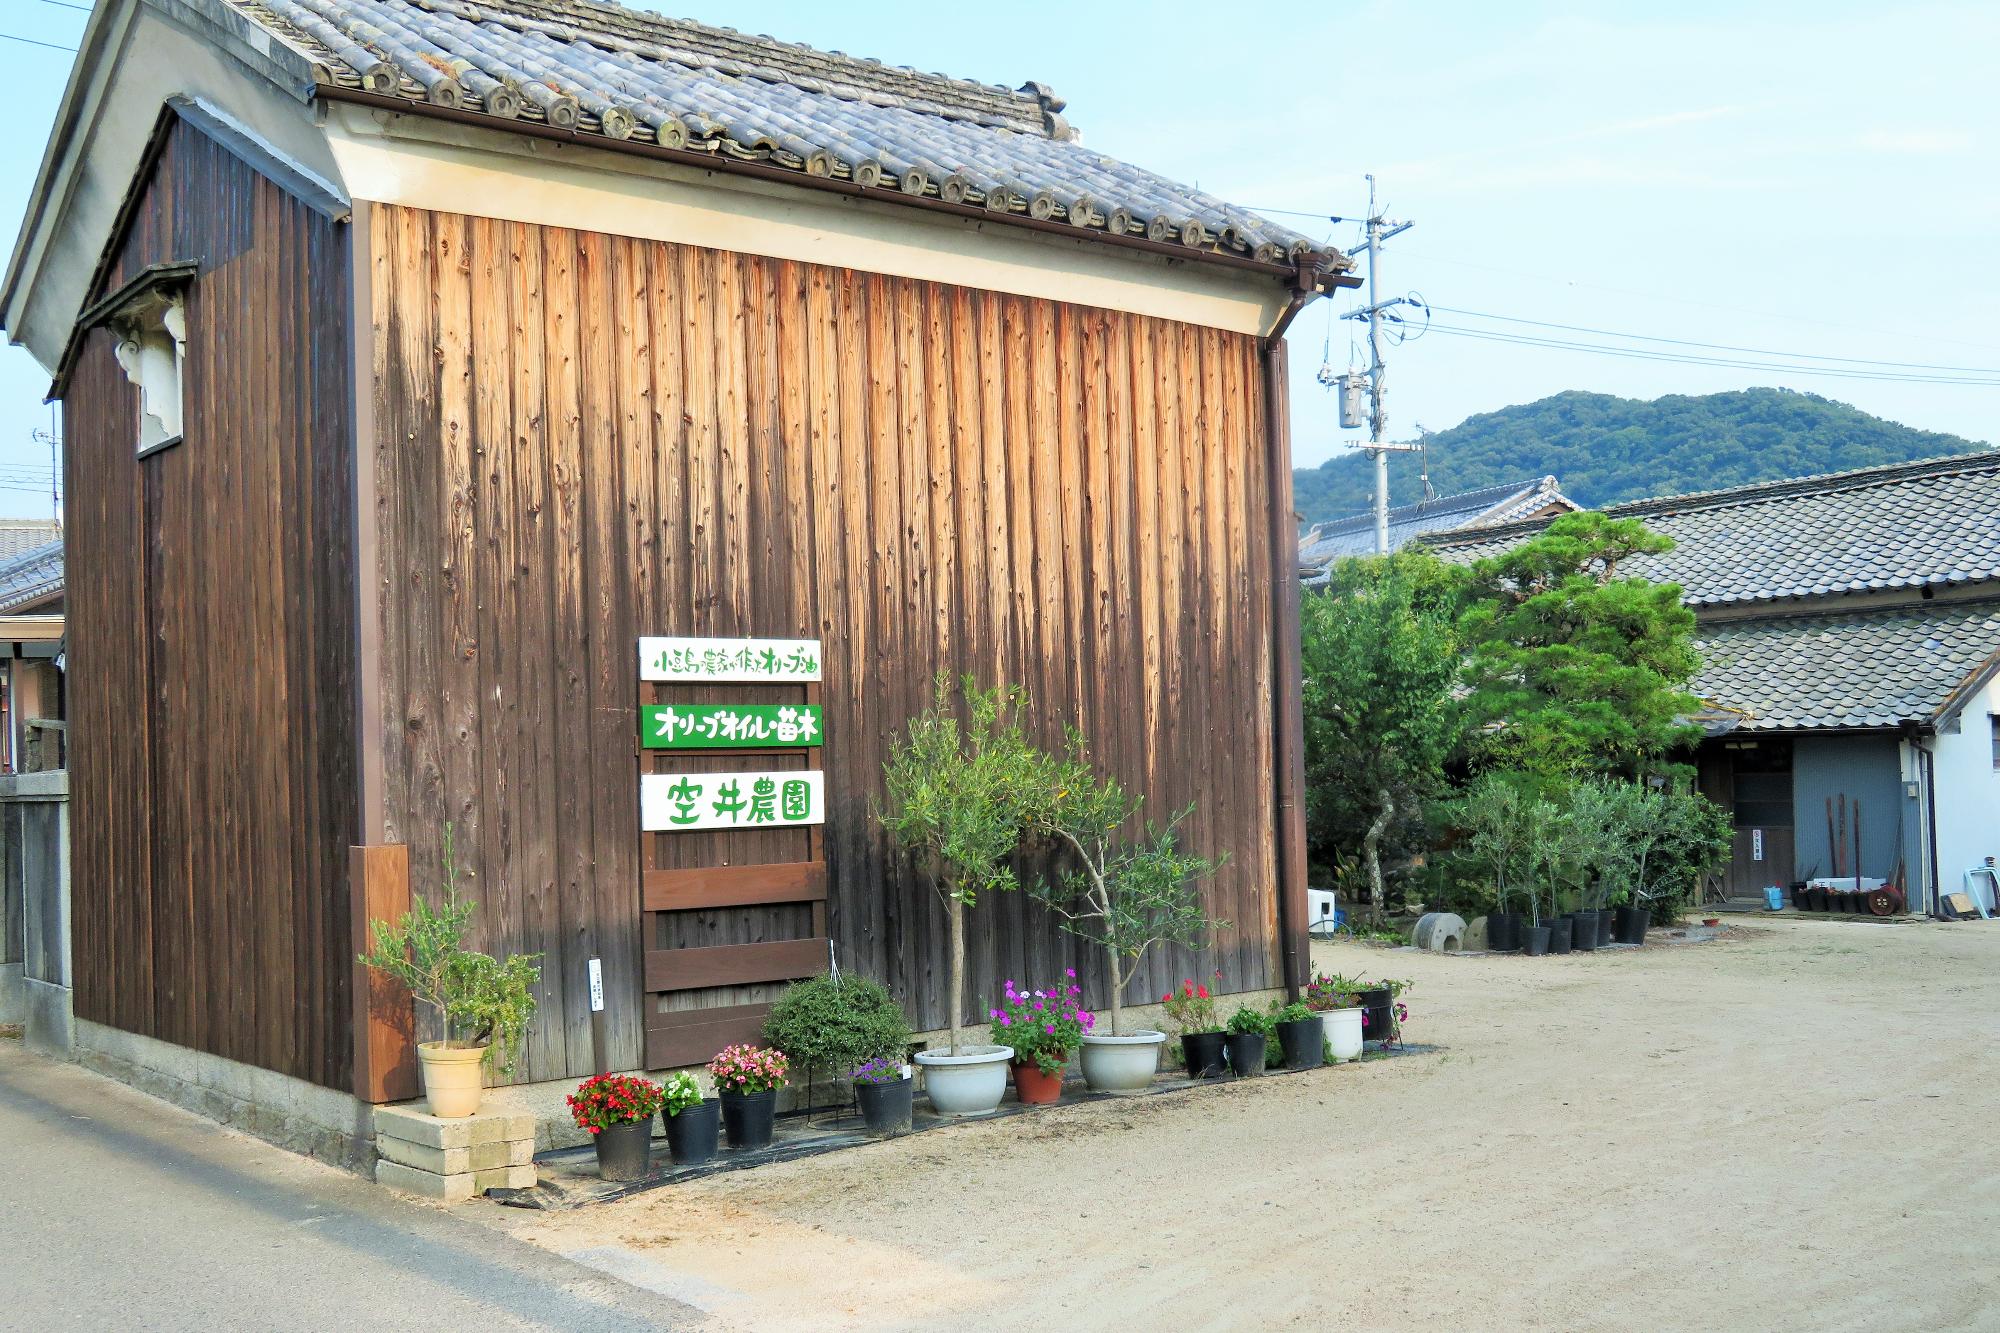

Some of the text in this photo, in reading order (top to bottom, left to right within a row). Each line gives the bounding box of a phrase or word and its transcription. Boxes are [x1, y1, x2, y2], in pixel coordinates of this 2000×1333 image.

[654, 706, 818, 742] オリーブオイル・苗木
[667, 776, 811, 824] 空井農園
